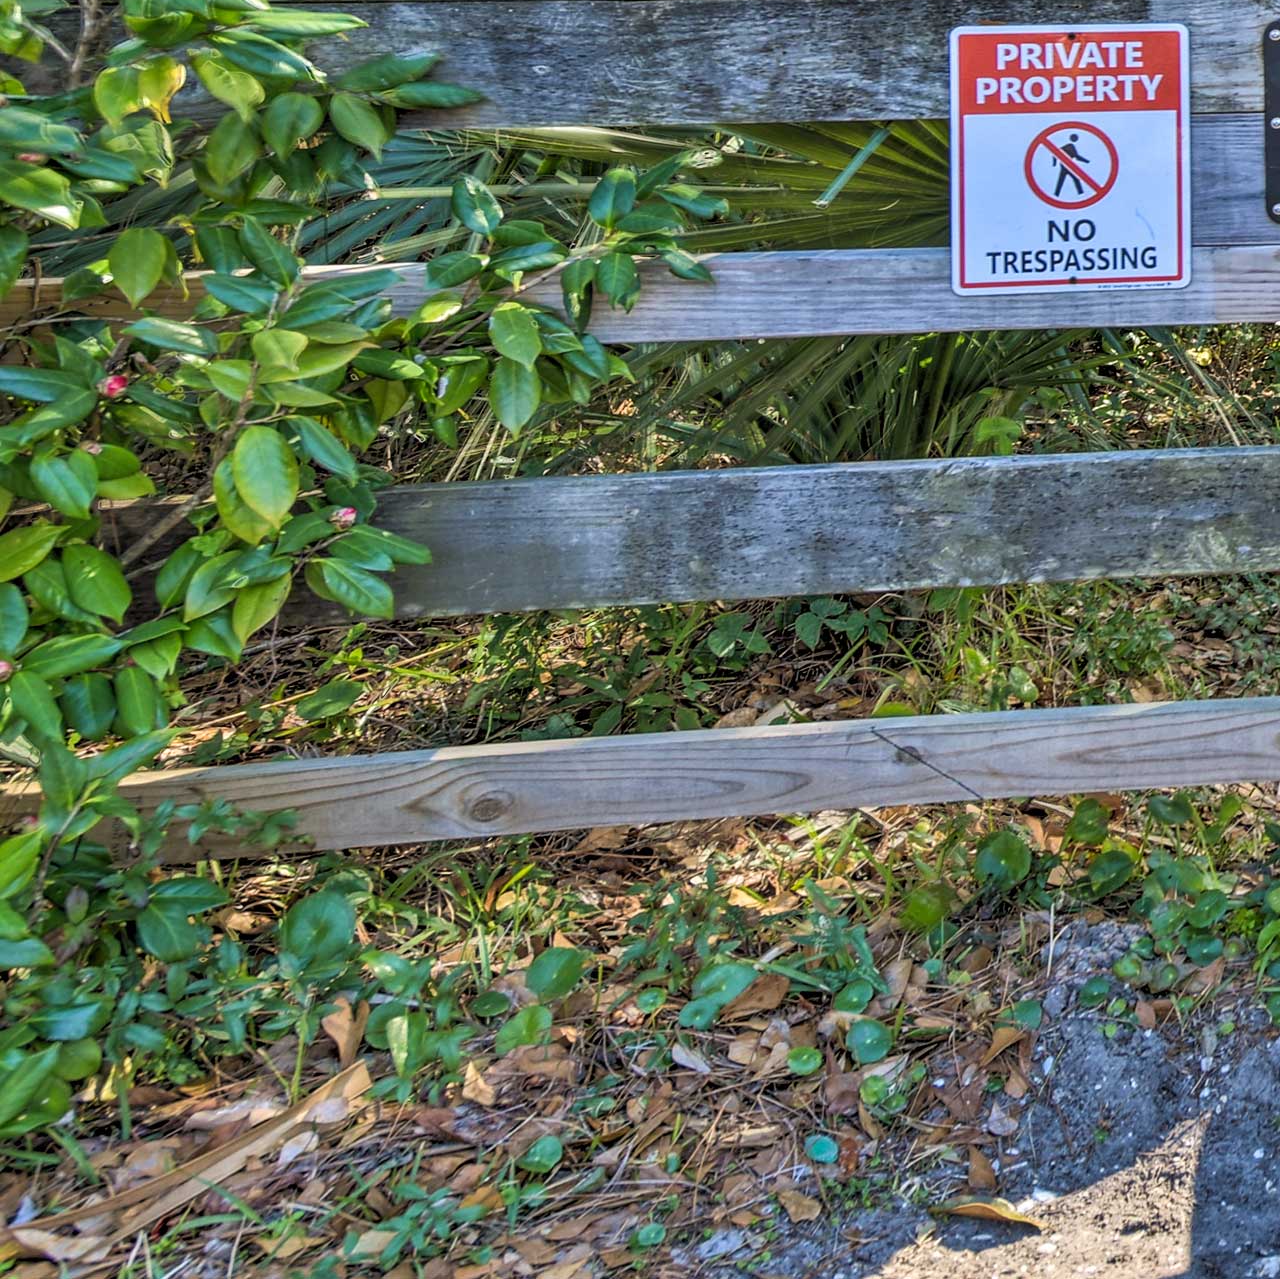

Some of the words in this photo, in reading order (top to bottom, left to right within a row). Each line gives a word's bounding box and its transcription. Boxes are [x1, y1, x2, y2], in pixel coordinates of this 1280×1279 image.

[996, 41, 1144, 71] PRIVATE
[976, 74, 1164, 105] PROPERTY
[1047, 219, 1097, 243] NO
[985, 246, 1157, 275] TRESPASSING
